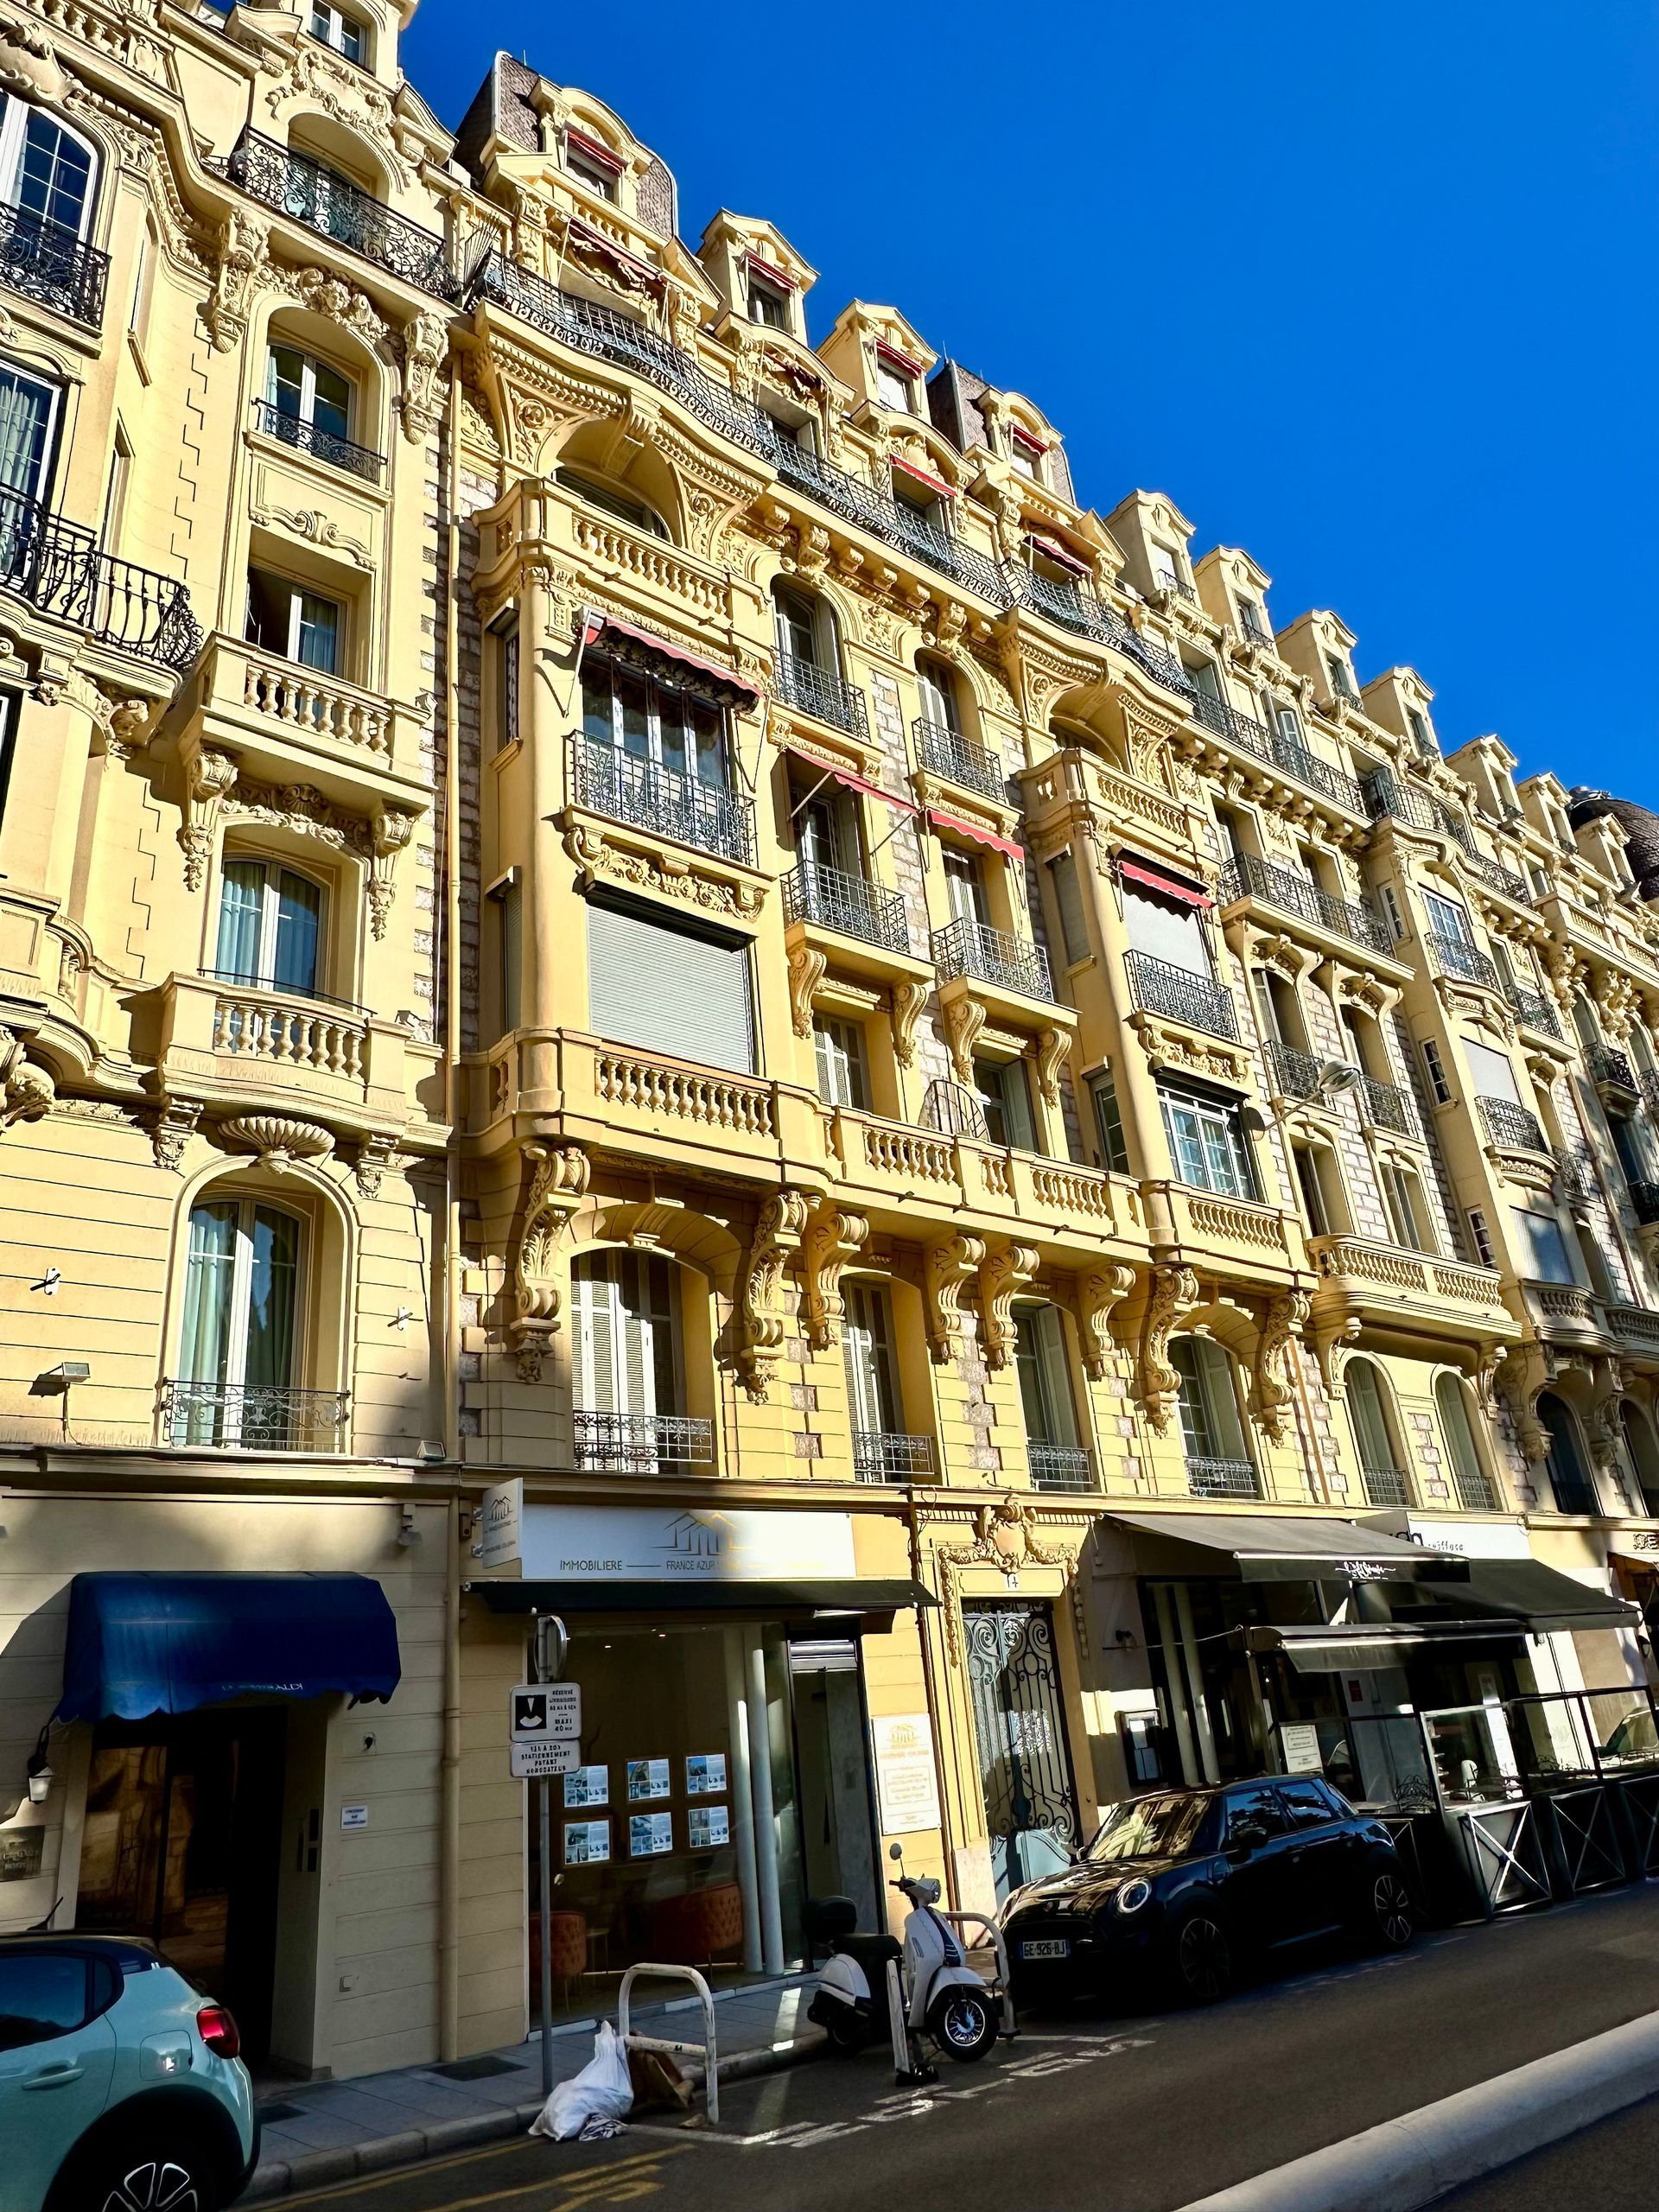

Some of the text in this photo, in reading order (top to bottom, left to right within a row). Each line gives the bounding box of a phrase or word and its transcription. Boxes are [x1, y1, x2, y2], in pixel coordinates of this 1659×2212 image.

[560, 1560, 622, 1571] IMMOBILIERE
[666, 1560, 695, 1570] FRANCE
[521, 1750, 570, 1760] STATIONNEMENT
[741, 2040, 1156, 2147] MOTOS
